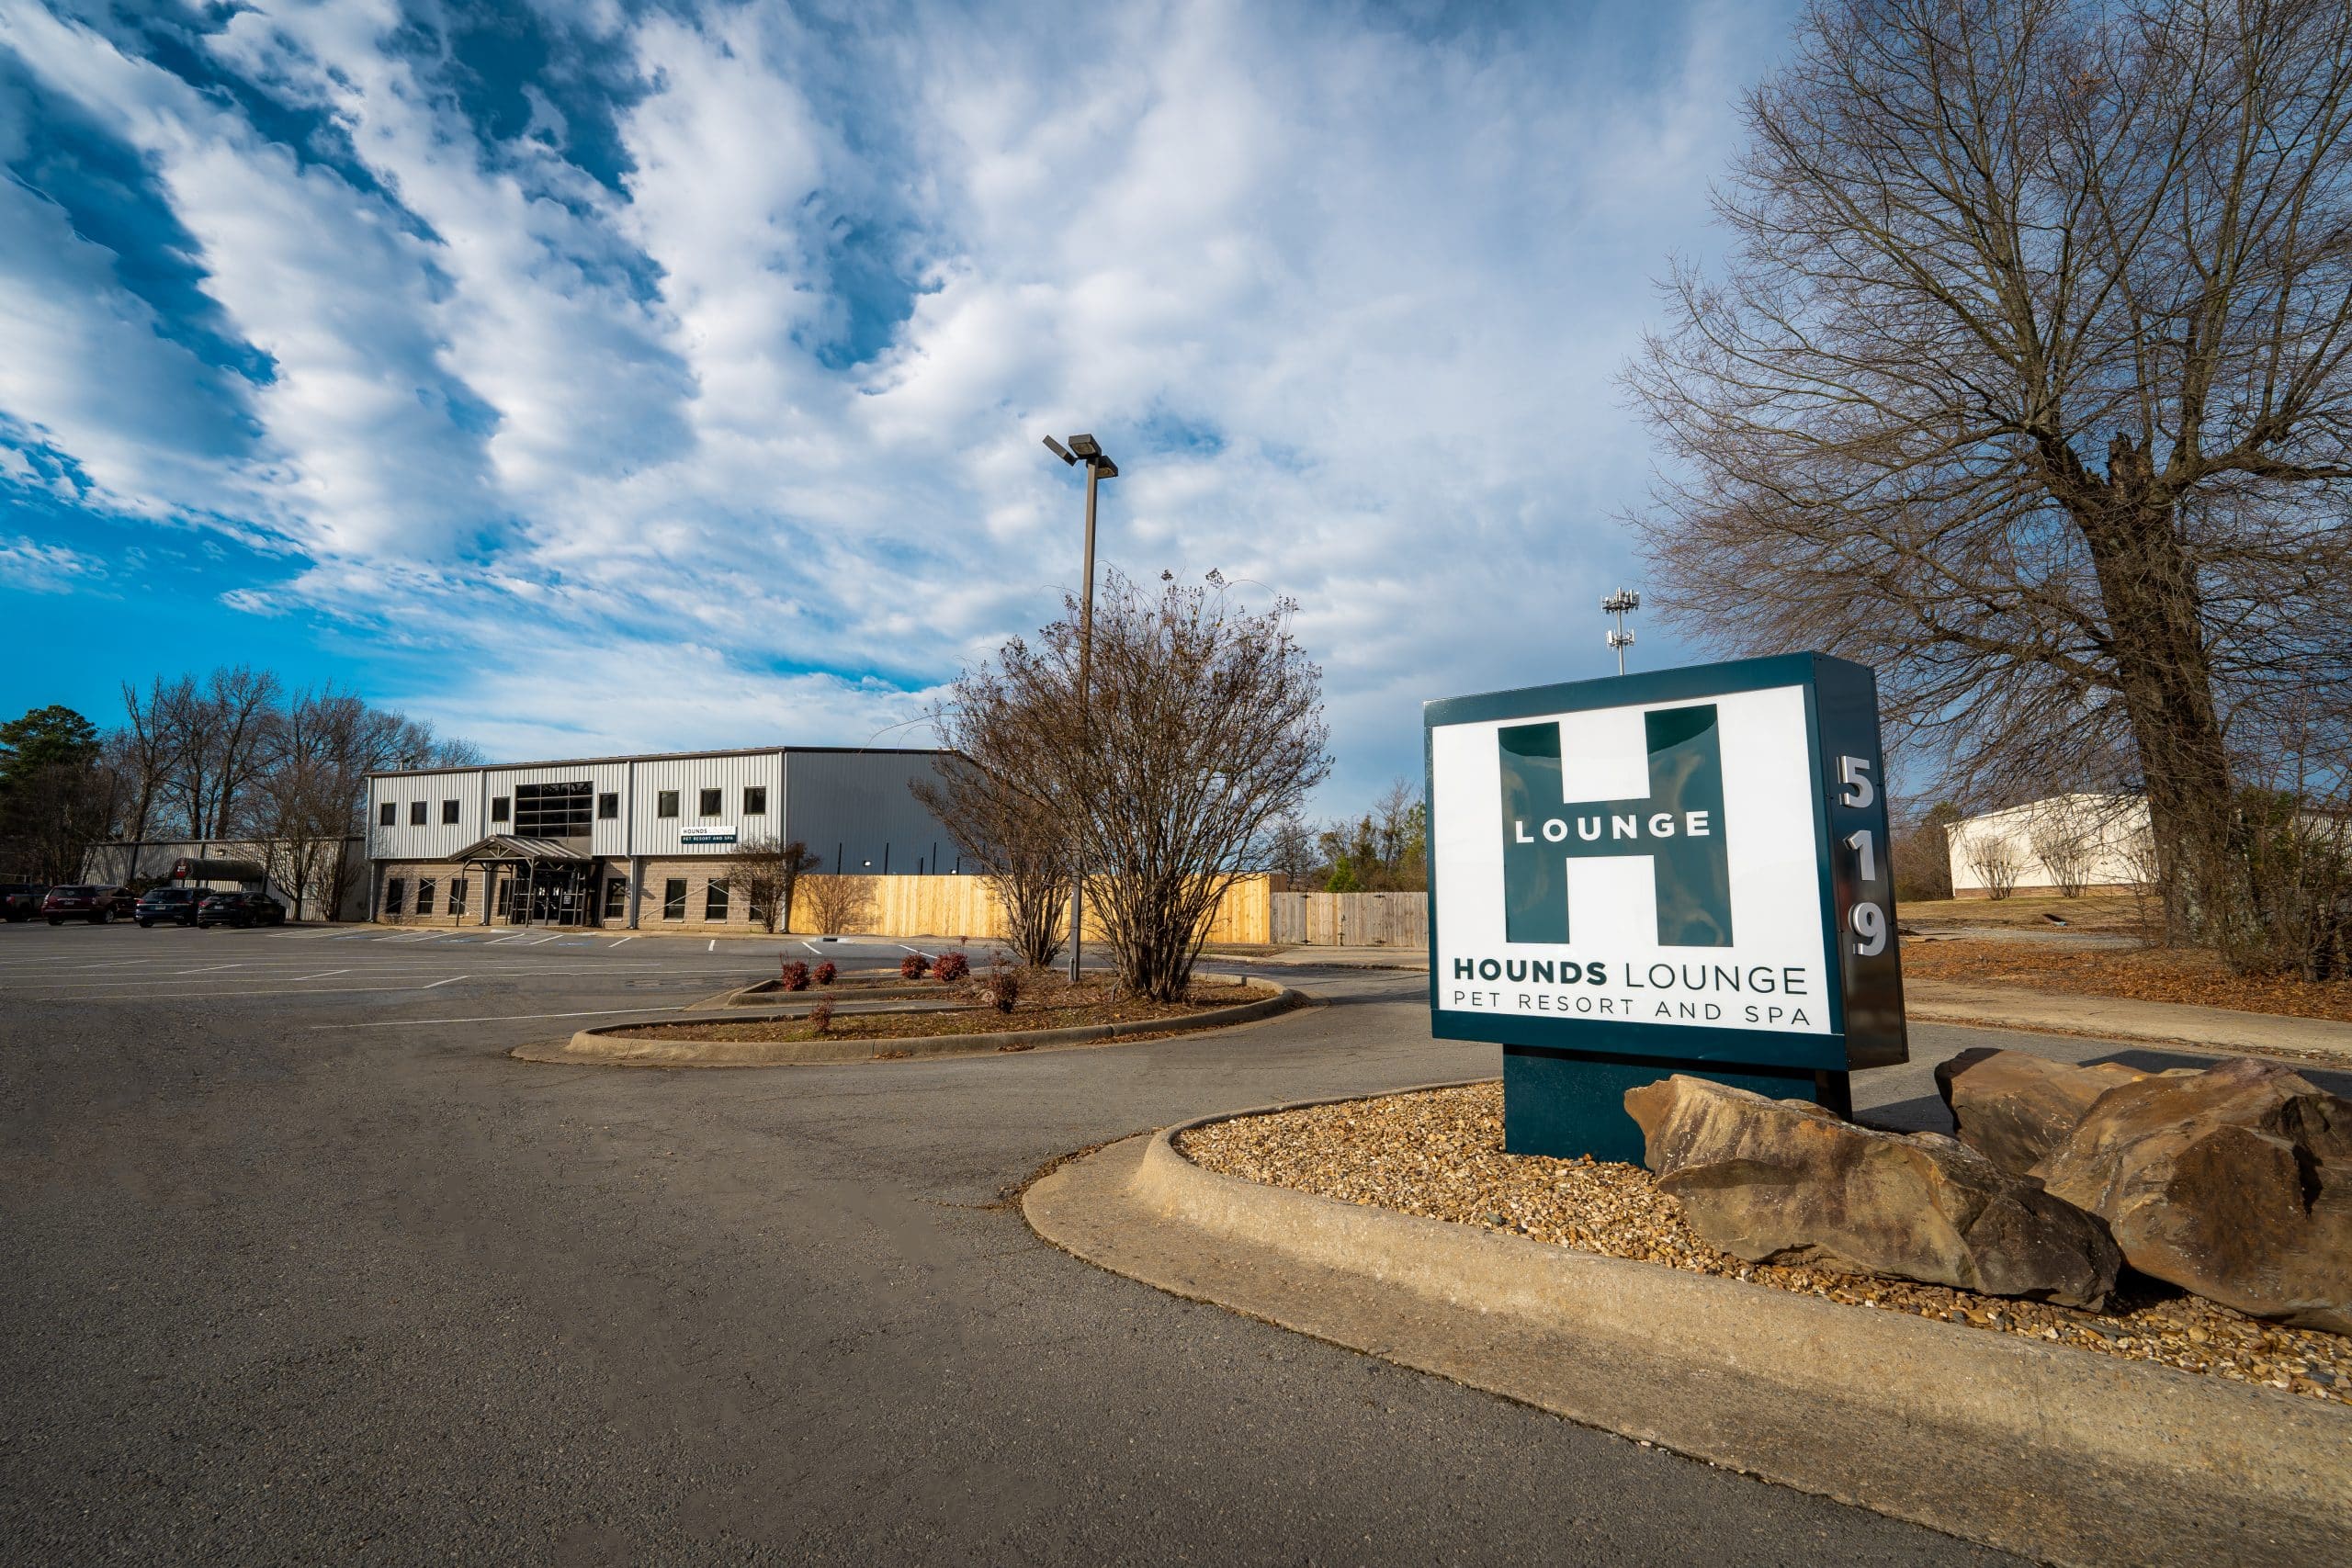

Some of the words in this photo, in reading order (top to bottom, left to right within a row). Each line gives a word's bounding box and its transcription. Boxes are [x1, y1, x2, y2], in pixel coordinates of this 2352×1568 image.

[1498, 704, 1734, 947] H
[1515, 811, 1711, 843] LOUNGE
[1837, 755, 1887, 956] 519
[1453, 958, 1607, 986] HOUNDS
[1626, 963, 1808, 995] LOUNGE
[1454, 991, 1500, 1008] PET
[1519, 994, 1634, 1015] RESORT
[1655, 1001, 1722, 1021] AND
[1745, 1006, 1811, 1026] SPA
